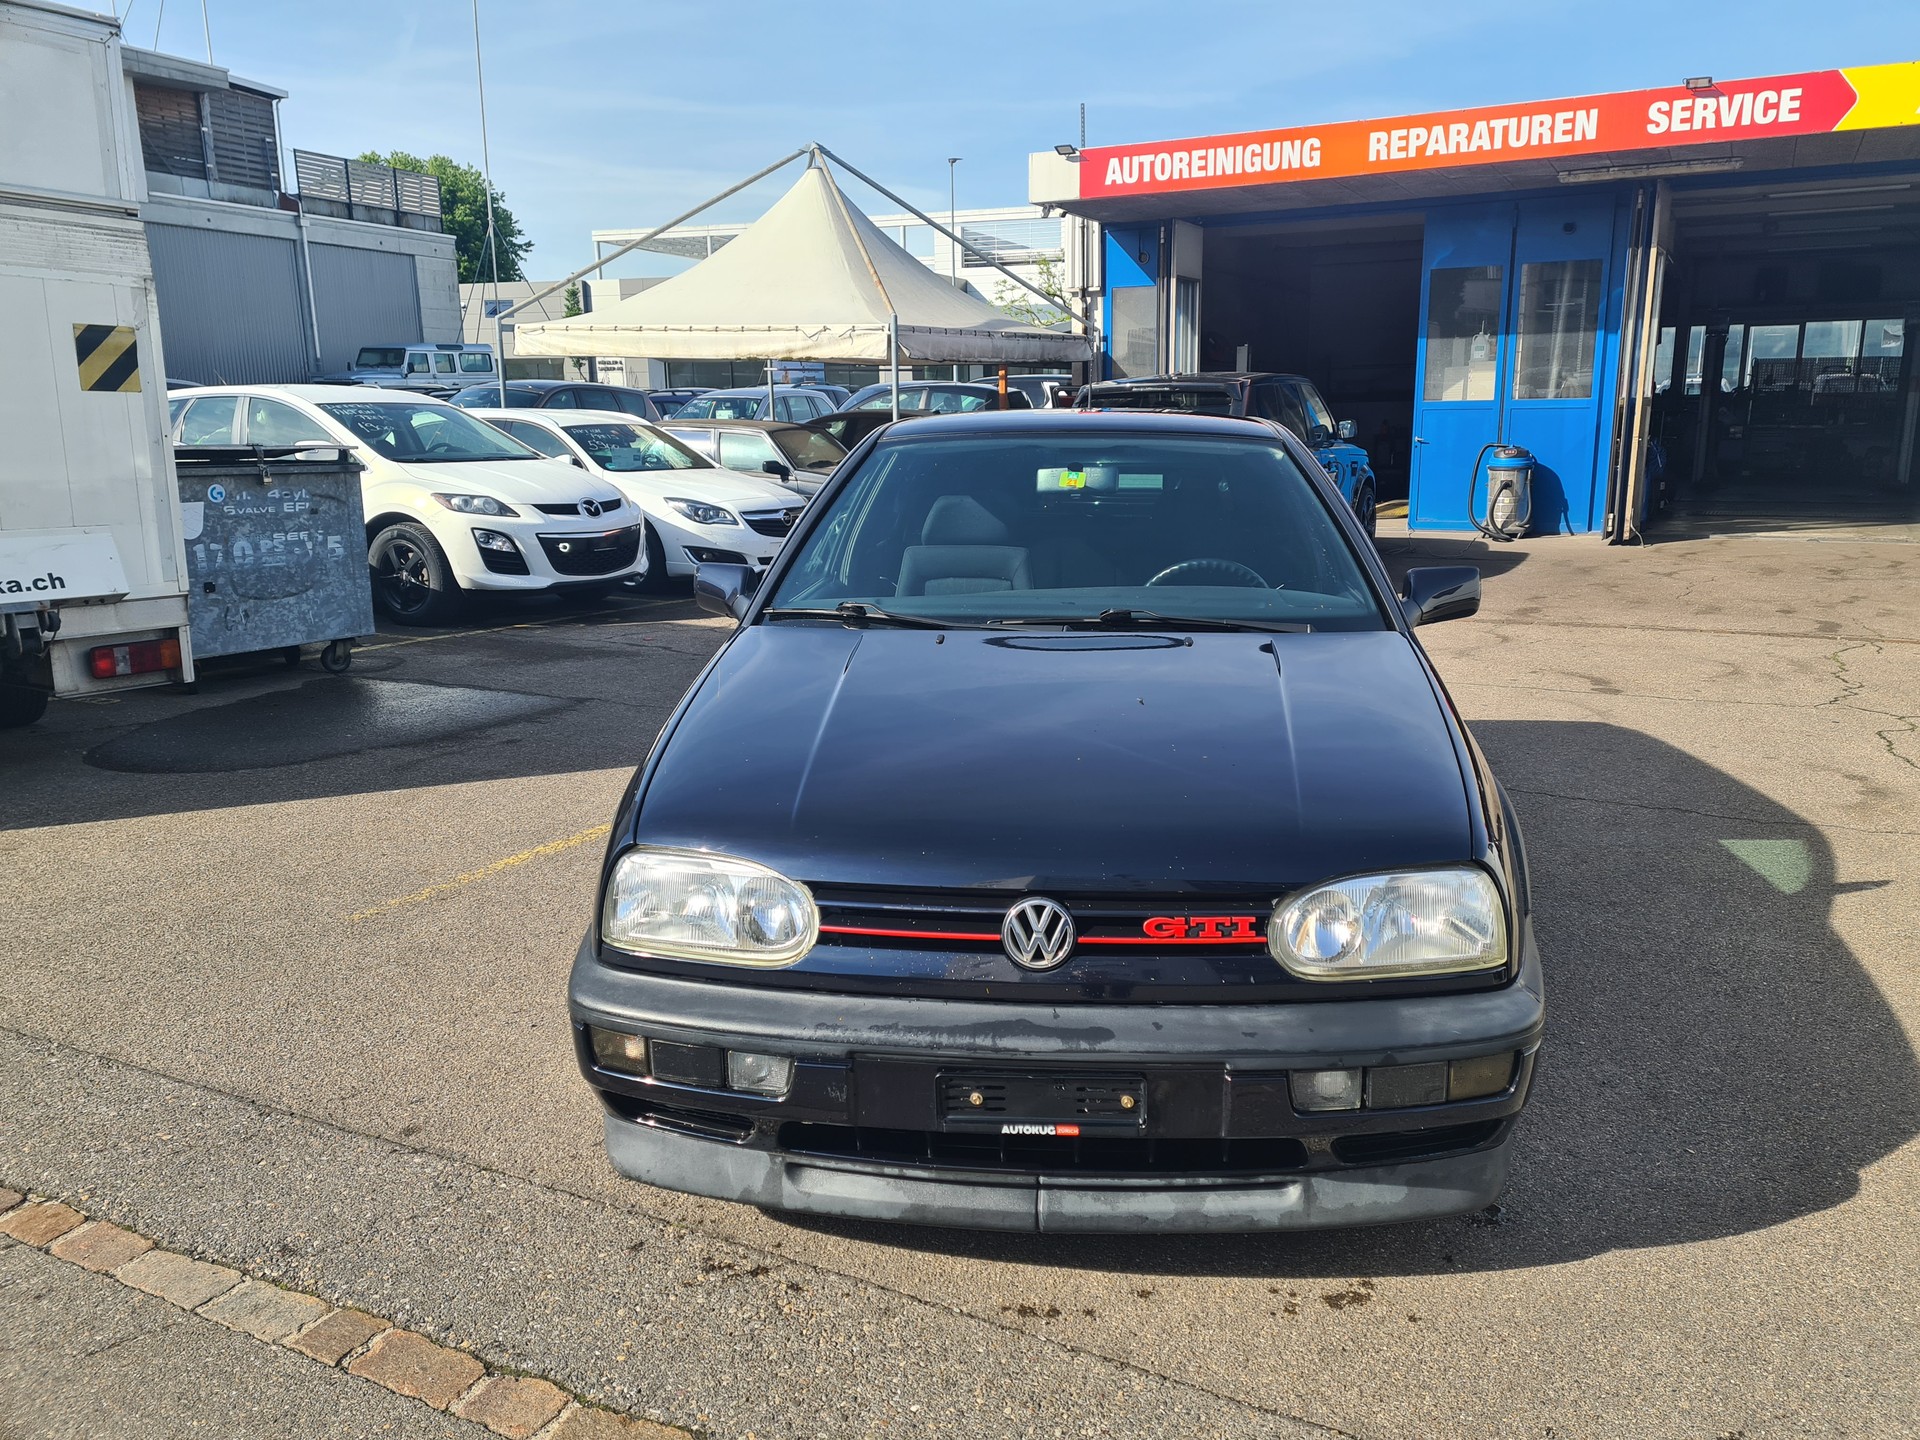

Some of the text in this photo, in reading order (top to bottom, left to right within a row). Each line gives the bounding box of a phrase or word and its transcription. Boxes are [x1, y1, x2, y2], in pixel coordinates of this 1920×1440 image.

[1105, 88, 1802, 185] AUTOREINIGUNG REPARATUREN SERVICE
[1142, 916, 1257, 938] GTI
